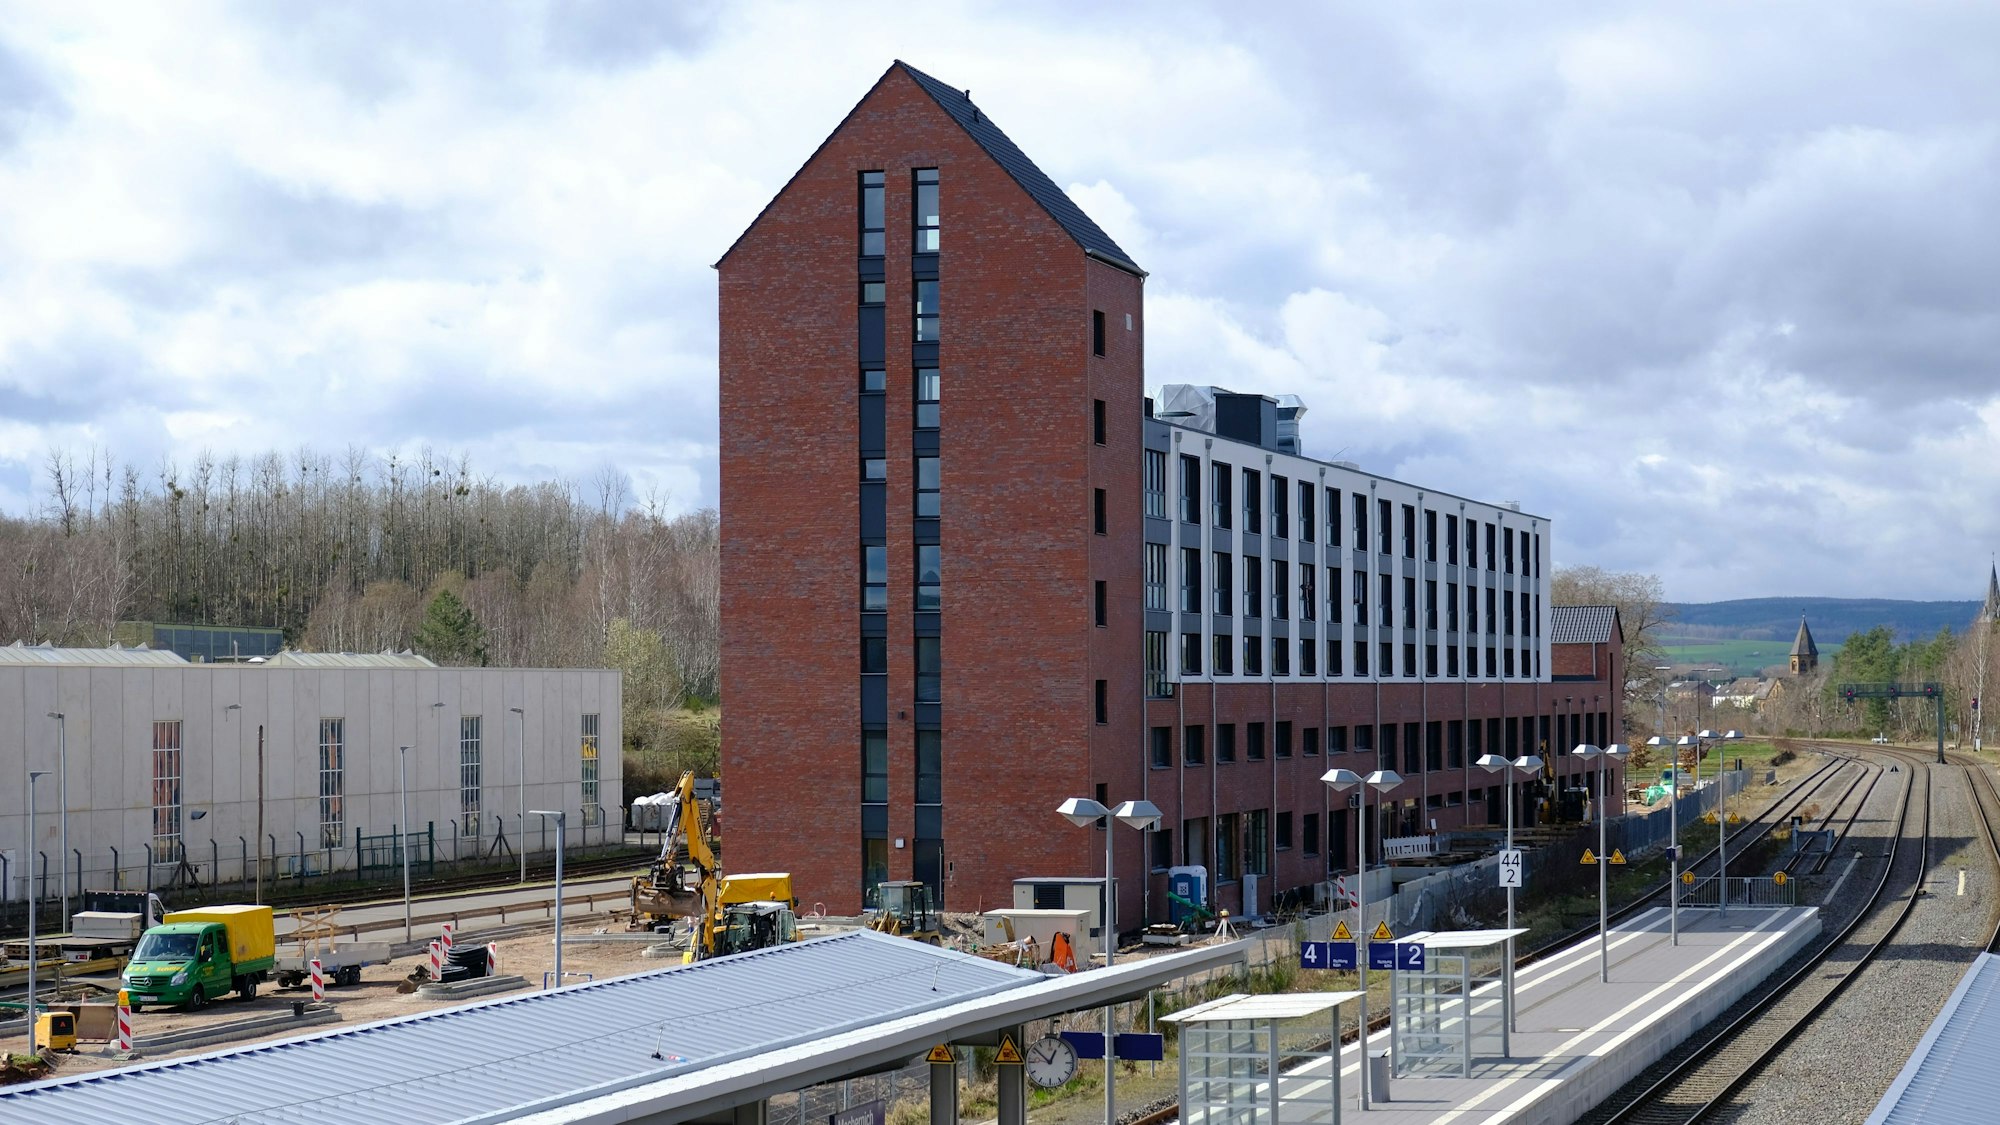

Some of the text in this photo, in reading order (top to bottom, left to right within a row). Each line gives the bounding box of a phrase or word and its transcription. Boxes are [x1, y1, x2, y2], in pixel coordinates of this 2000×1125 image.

[1501, 853, 1520, 867] 44
[1506, 869, 1515, 882] 2
[1304, 943, 1317, 963] 4
[1408, 945, 1422, 965] 2
[838, 1109, 874, 1125] hernich
